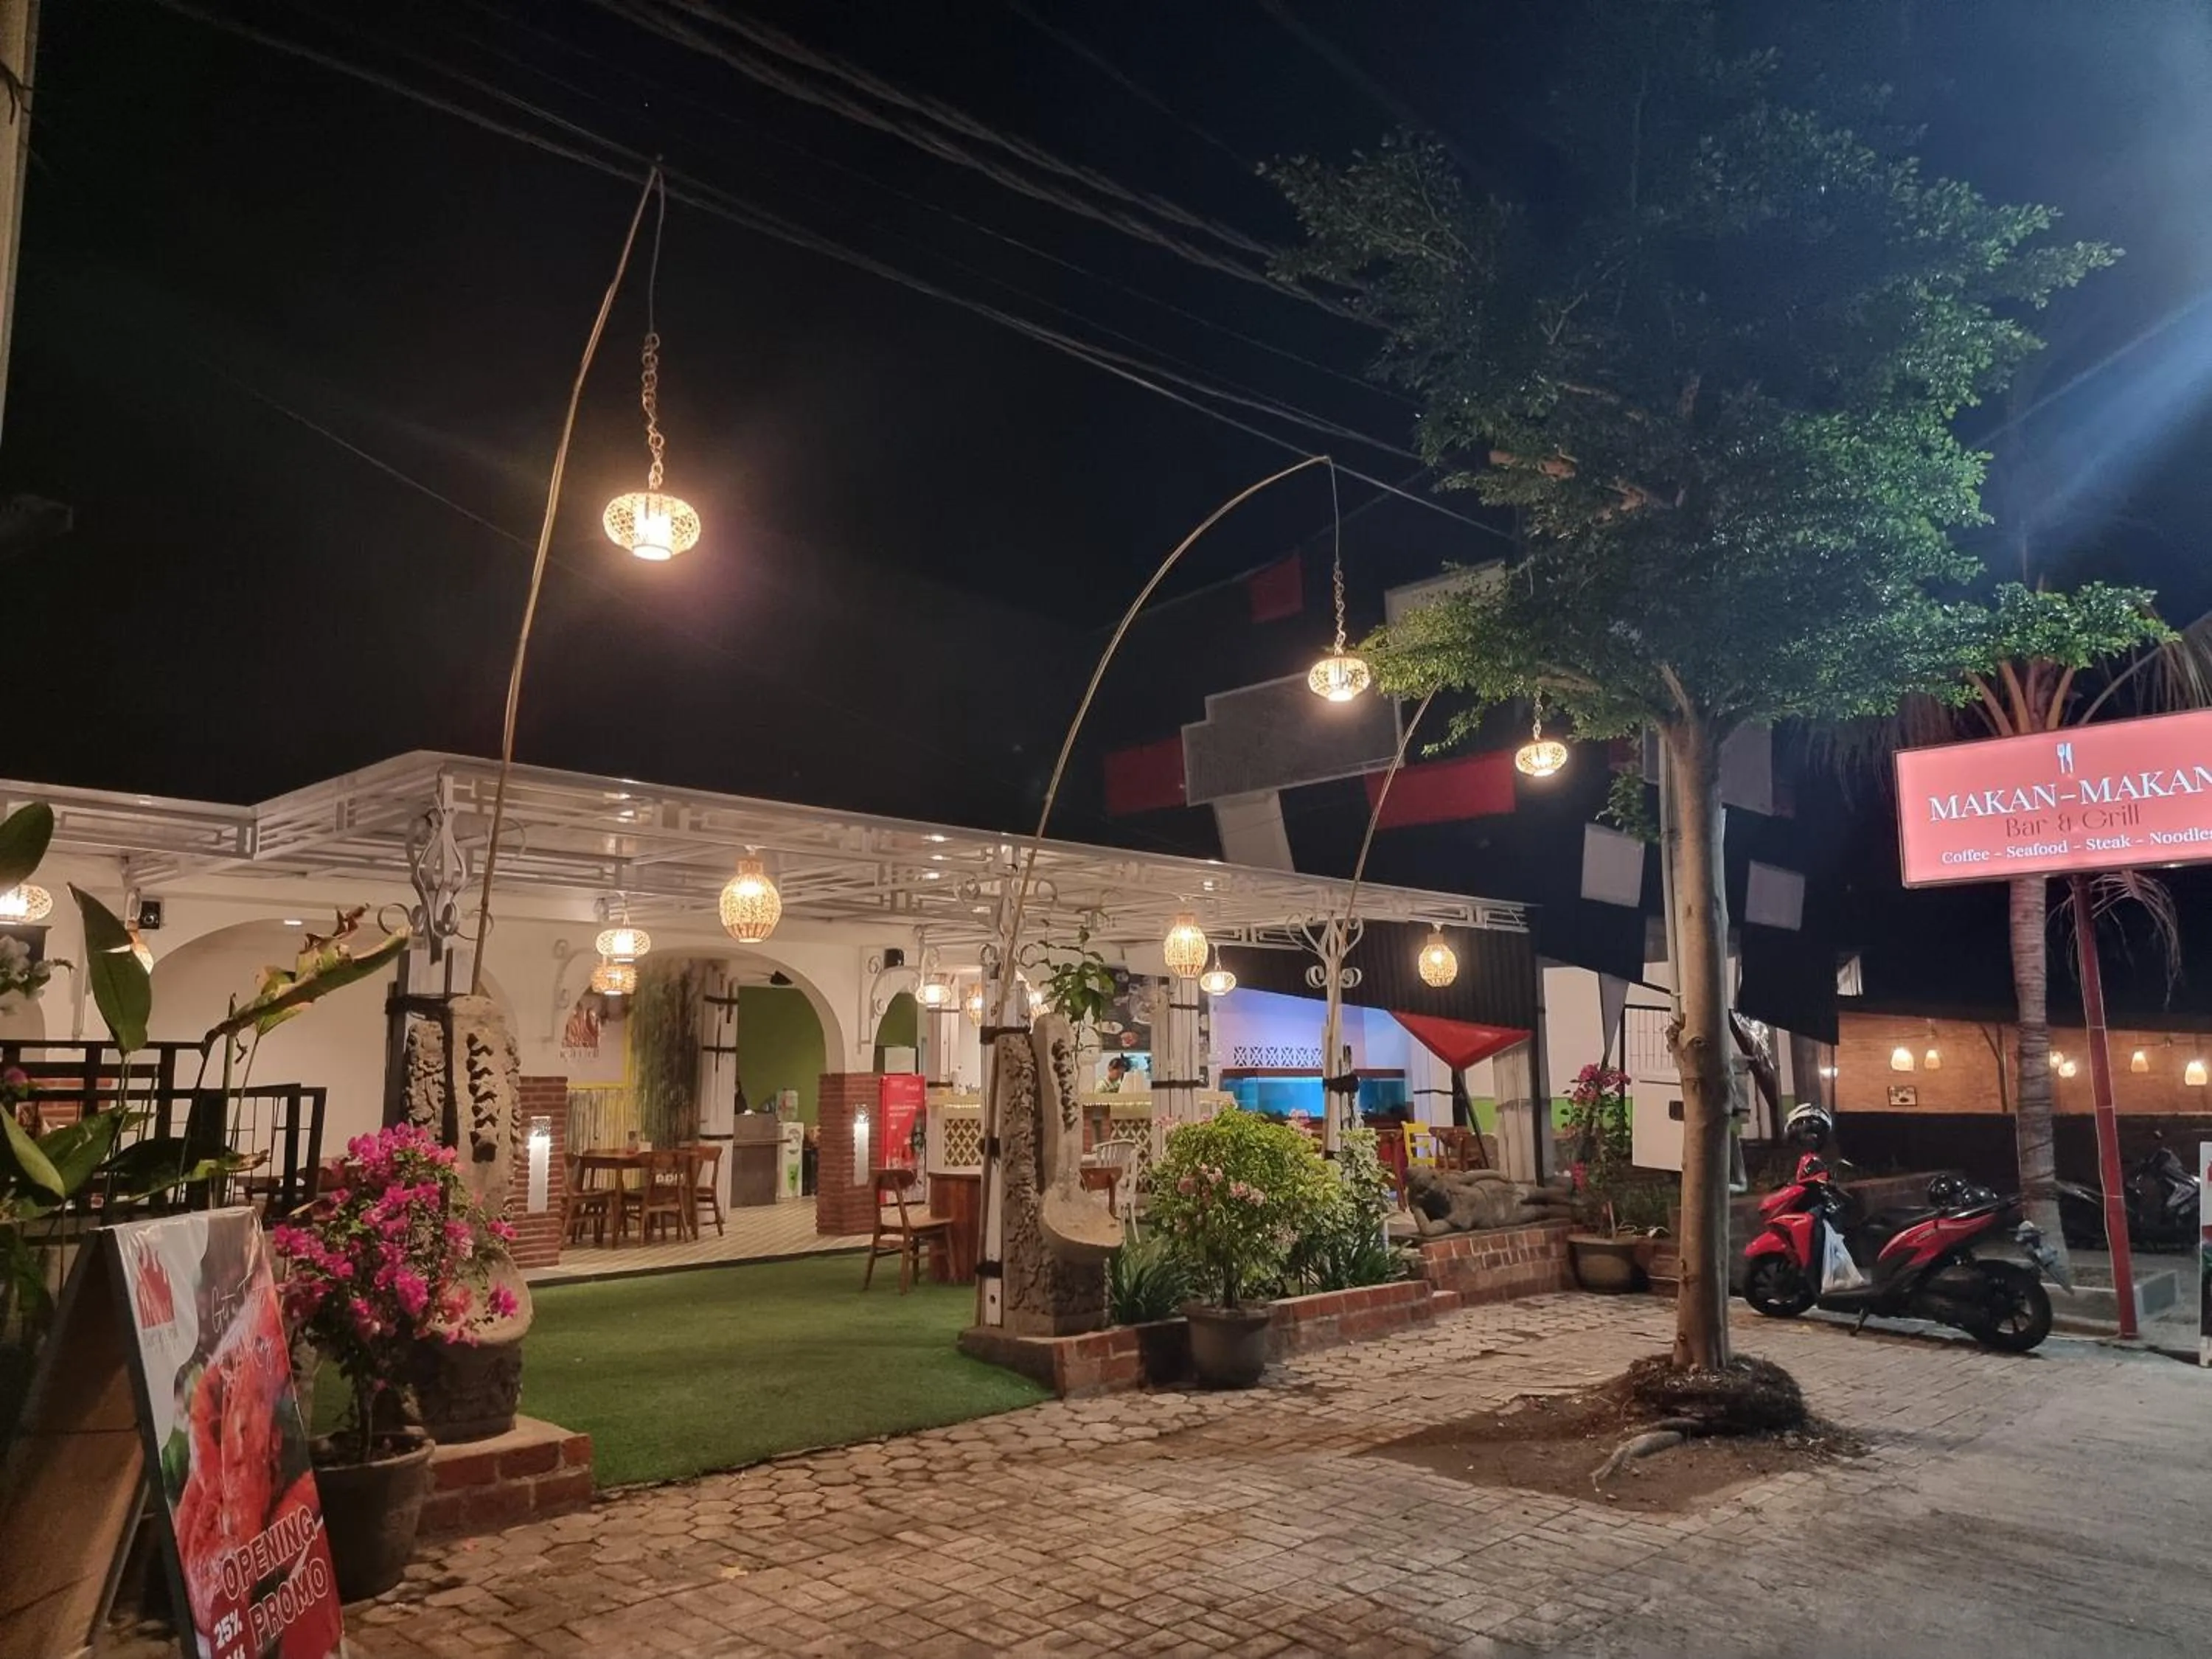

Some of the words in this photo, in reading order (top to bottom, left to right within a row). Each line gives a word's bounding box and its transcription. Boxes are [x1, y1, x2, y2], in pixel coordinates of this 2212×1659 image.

[2006, 817, 2049, 838] Bar
[2082, 804, 2140, 829] Grill
[1941, 849, 1990, 864] Coffee
[2006, 840, 2068, 858] Seafood
[2085, 834, 2131, 850] Steak
[223, 1505, 318, 1601] OPENING
[248, 1557, 329, 1652] PROMO
[214, 1608, 243, 1650] 25%
